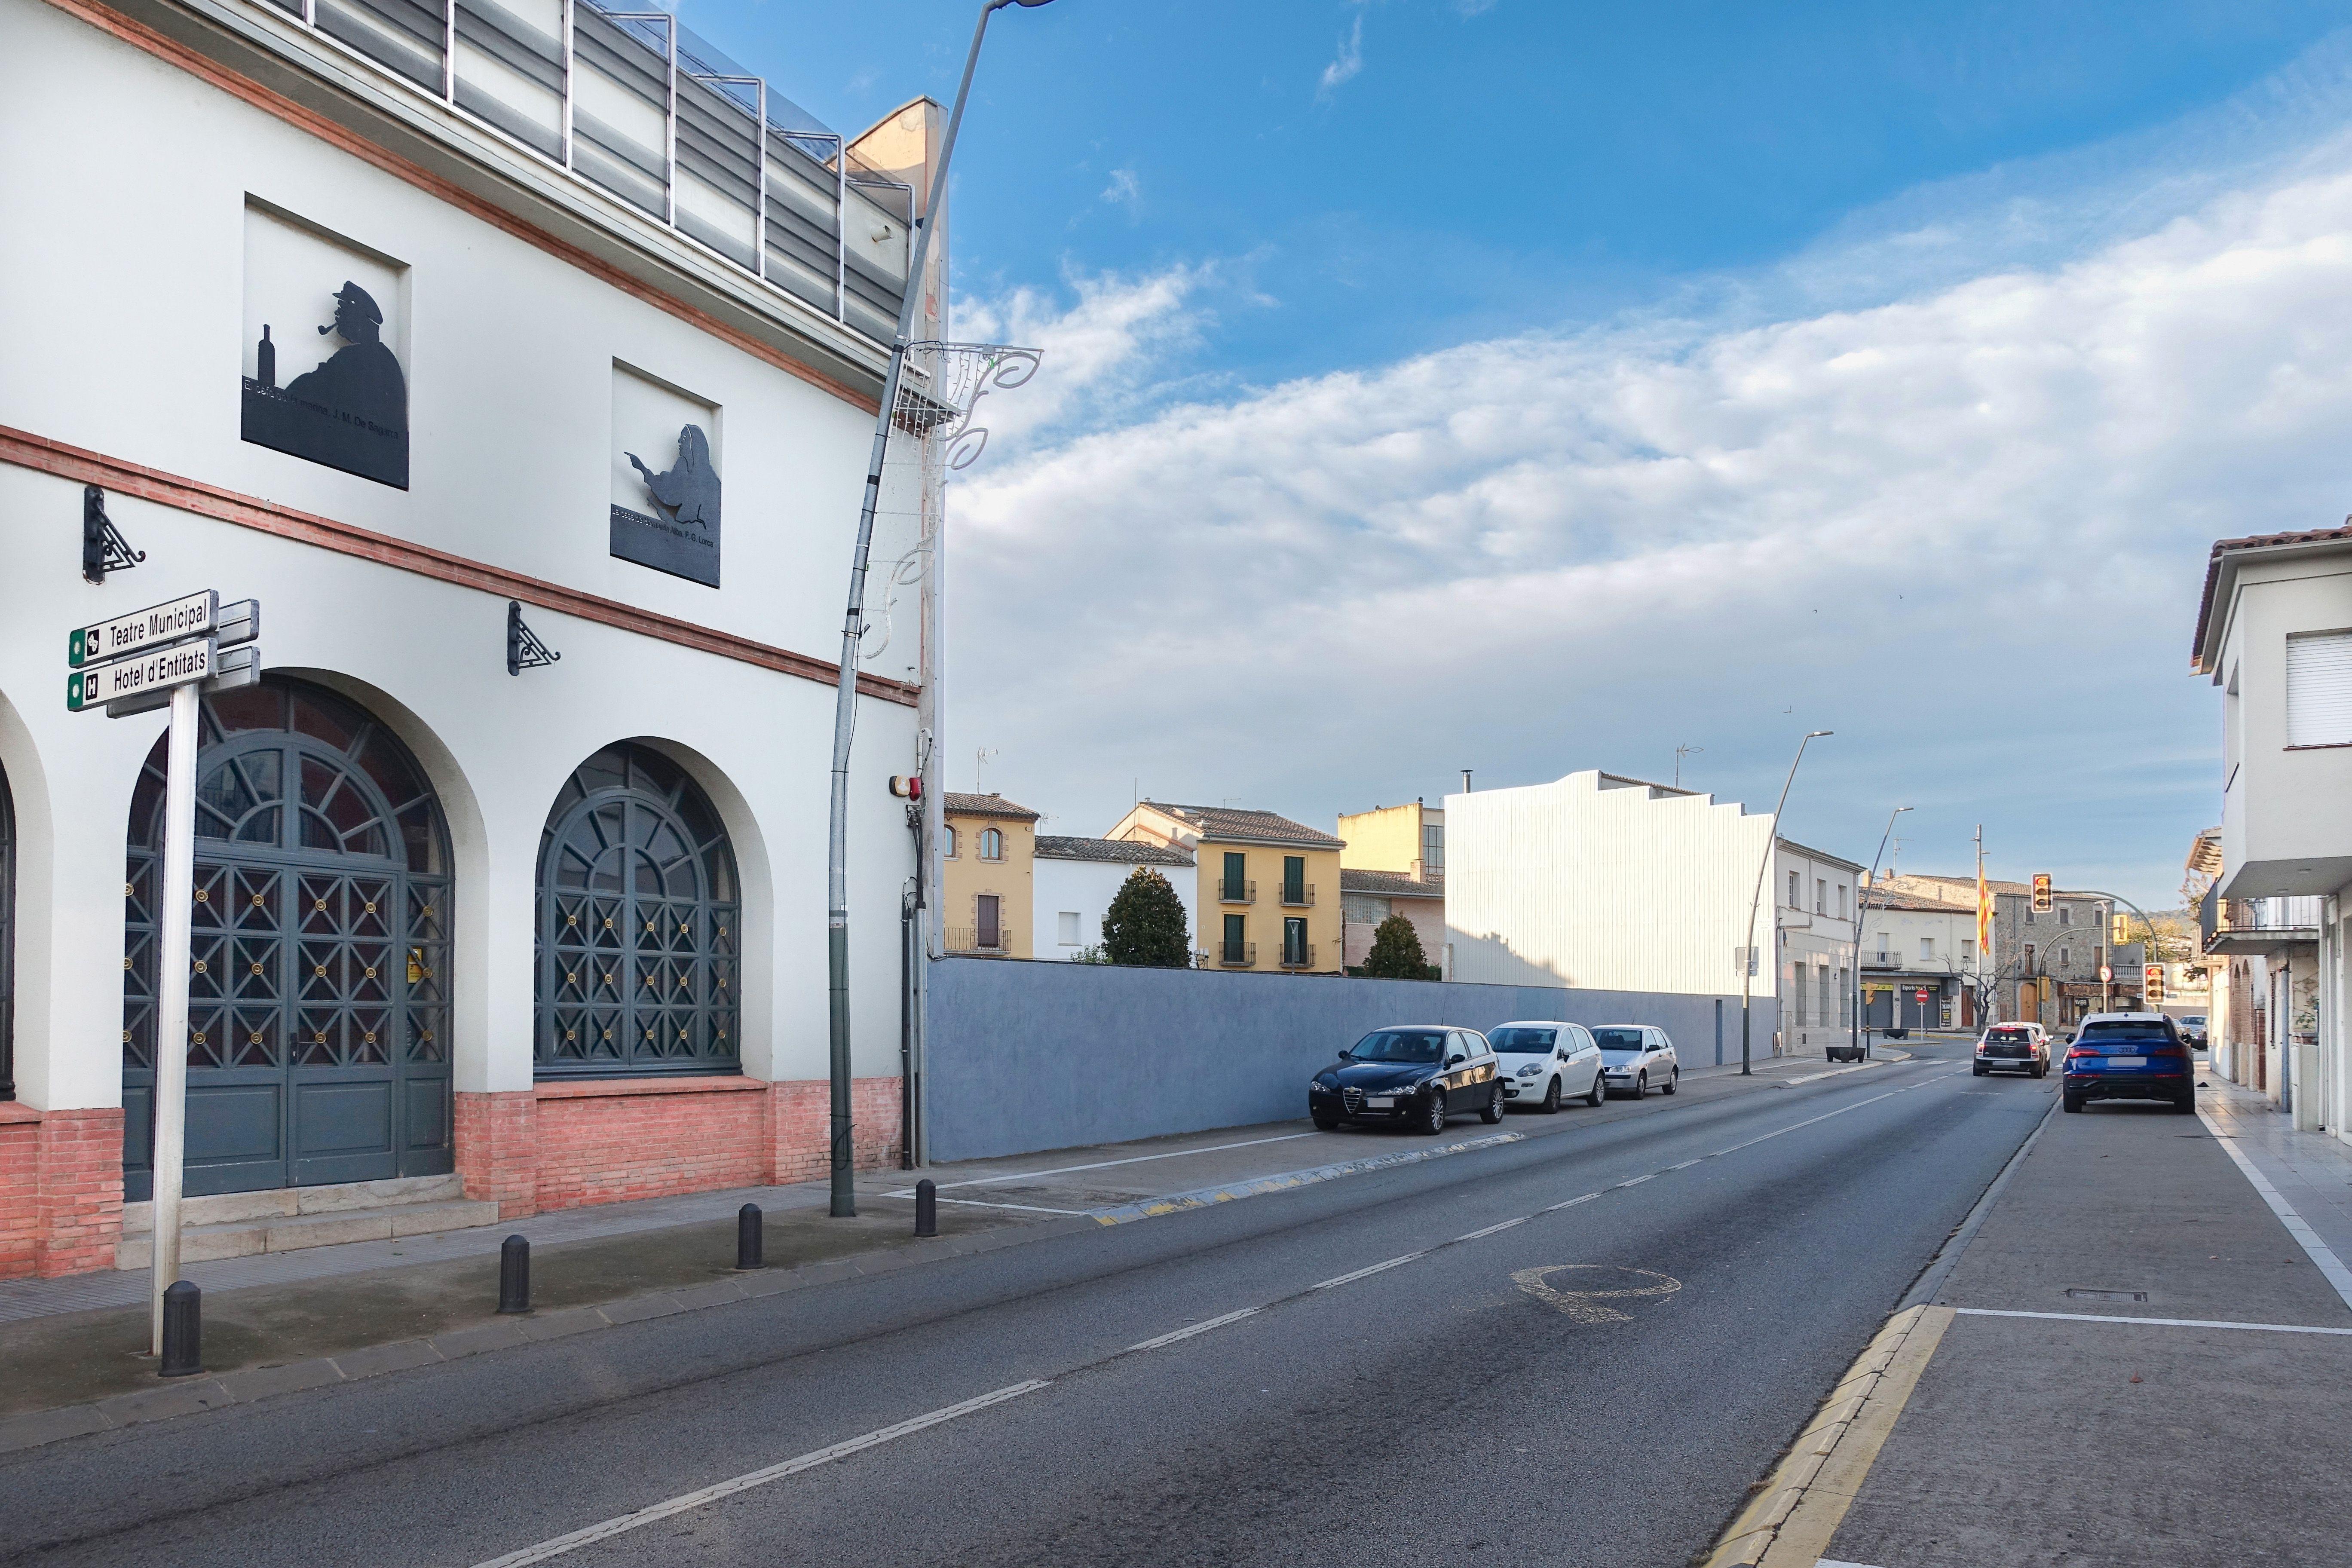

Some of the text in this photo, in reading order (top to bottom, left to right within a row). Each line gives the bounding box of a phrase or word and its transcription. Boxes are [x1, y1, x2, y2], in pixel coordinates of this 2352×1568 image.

[355, 416, 365, 428] De
[699, 536, 713, 548] Lorca
[110, 599, 206, 647] Teatre Municipal
[114, 650, 205, 691] Hotel d'Entitats
